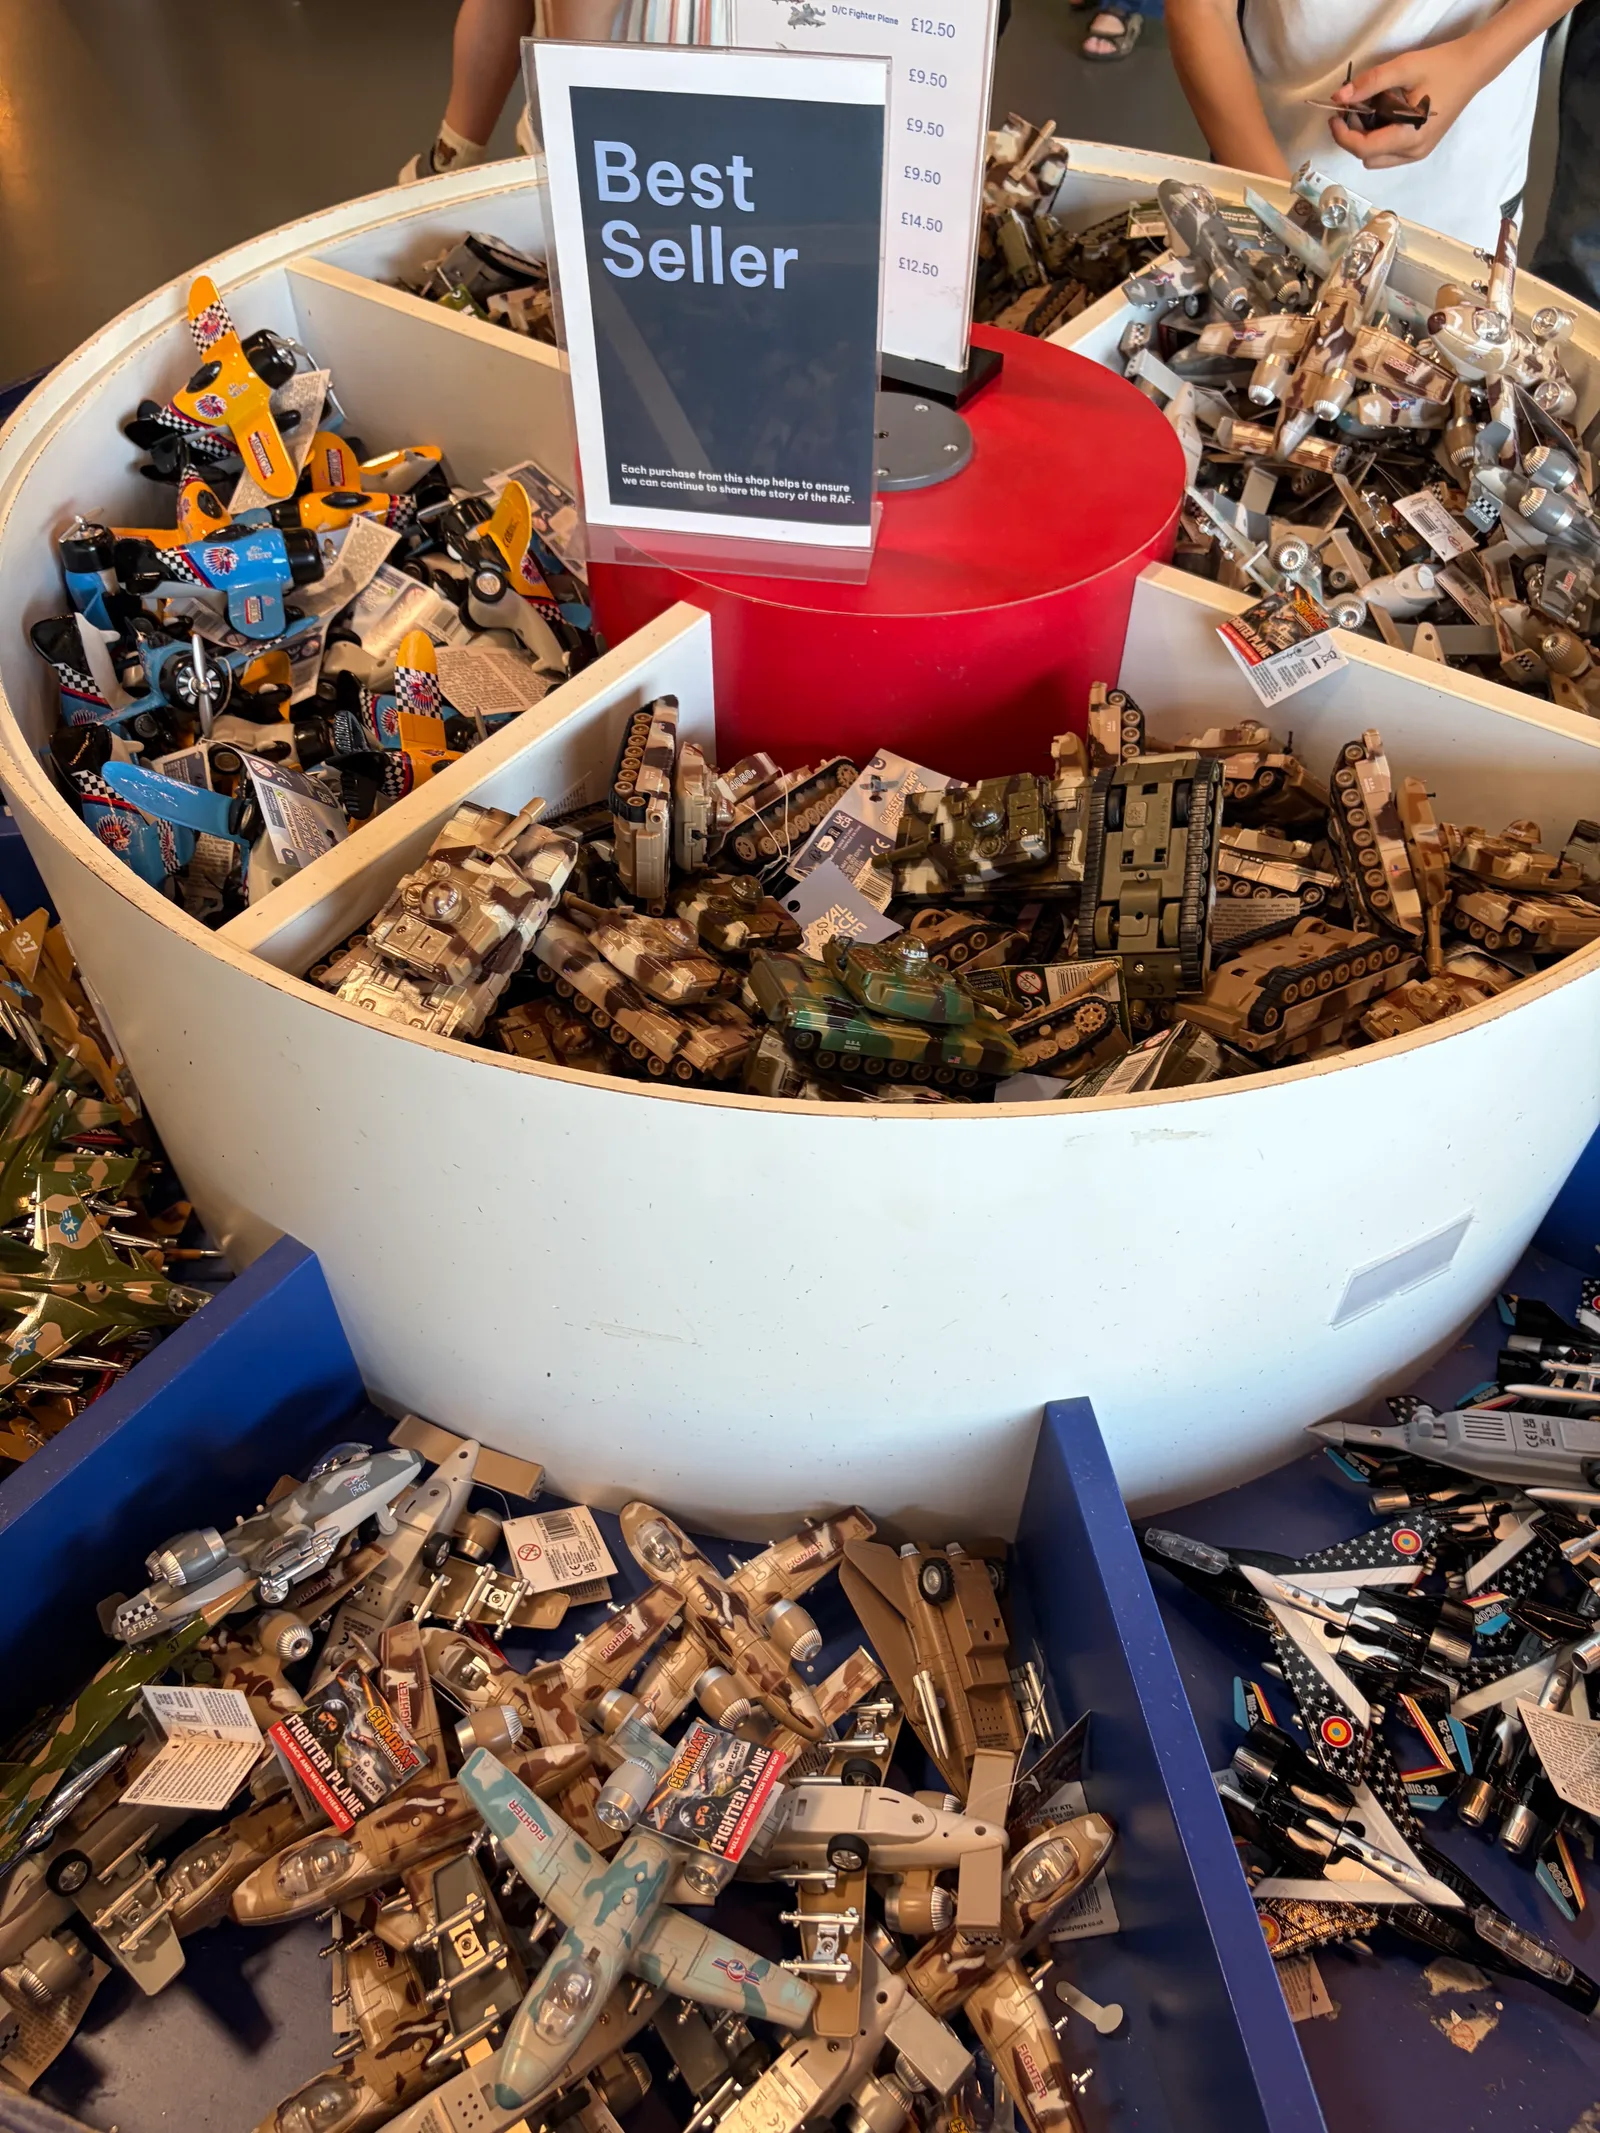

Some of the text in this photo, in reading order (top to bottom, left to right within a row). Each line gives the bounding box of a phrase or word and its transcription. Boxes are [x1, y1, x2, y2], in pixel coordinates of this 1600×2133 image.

[831, 5, 956, 39] D/C Fighter Plane £12.50
[909, 68, 948, 89] £9.50
[906, 117, 945, 138] £9.50
[594, 140, 755, 212] Best
[904, 165, 942, 186] £9.50
[901, 212, 943, 233] £14.50
[601, 220, 799, 289] Seller
[898, 257, 939, 278] £12.50
[621, 463, 850, 493] Each purchase from this shop helps to ensure
[622, 477, 855, 504] we can continue to share the story of the RAF.
[880, 792, 905, 825] CLASSIC
[900, 770, 919, 795] WING
[16, 931, 38, 953] 37
[786, 1540, 825, 1570] FIGHTER
[126, 1614, 158, 1636] AFRES
[599, 1623, 636, 1660] FIGHTER
[1246, 1693, 1259, 1728] MIG-2
[366, 1705, 420, 1768] COMBAT
[374, 1733, 405, 1774] MISSION
[691, 1733, 716, 1774] MISSION
[285, 1713, 366, 1818] FIGHTER PLANE
[667, 1726, 710, 1790] COMBAT
[726, 1742, 742, 1773] DIE CAST
[276, 1726, 350, 1825] PULL BACK AND WATCH THEM GO!
[354, 1764, 385, 1794] DIE CAST
[1404, 1782, 1439, 1796] MIG-29
[711, 1747, 771, 1851] FIGHTER PLANE
[729, 1753, 781, 1855] PULL BACK AND WATCH THEM GO!
[507, 1799, 548, 1842] FIGHTER
[1017, 2042, 1047, 2100] FIGHTER
